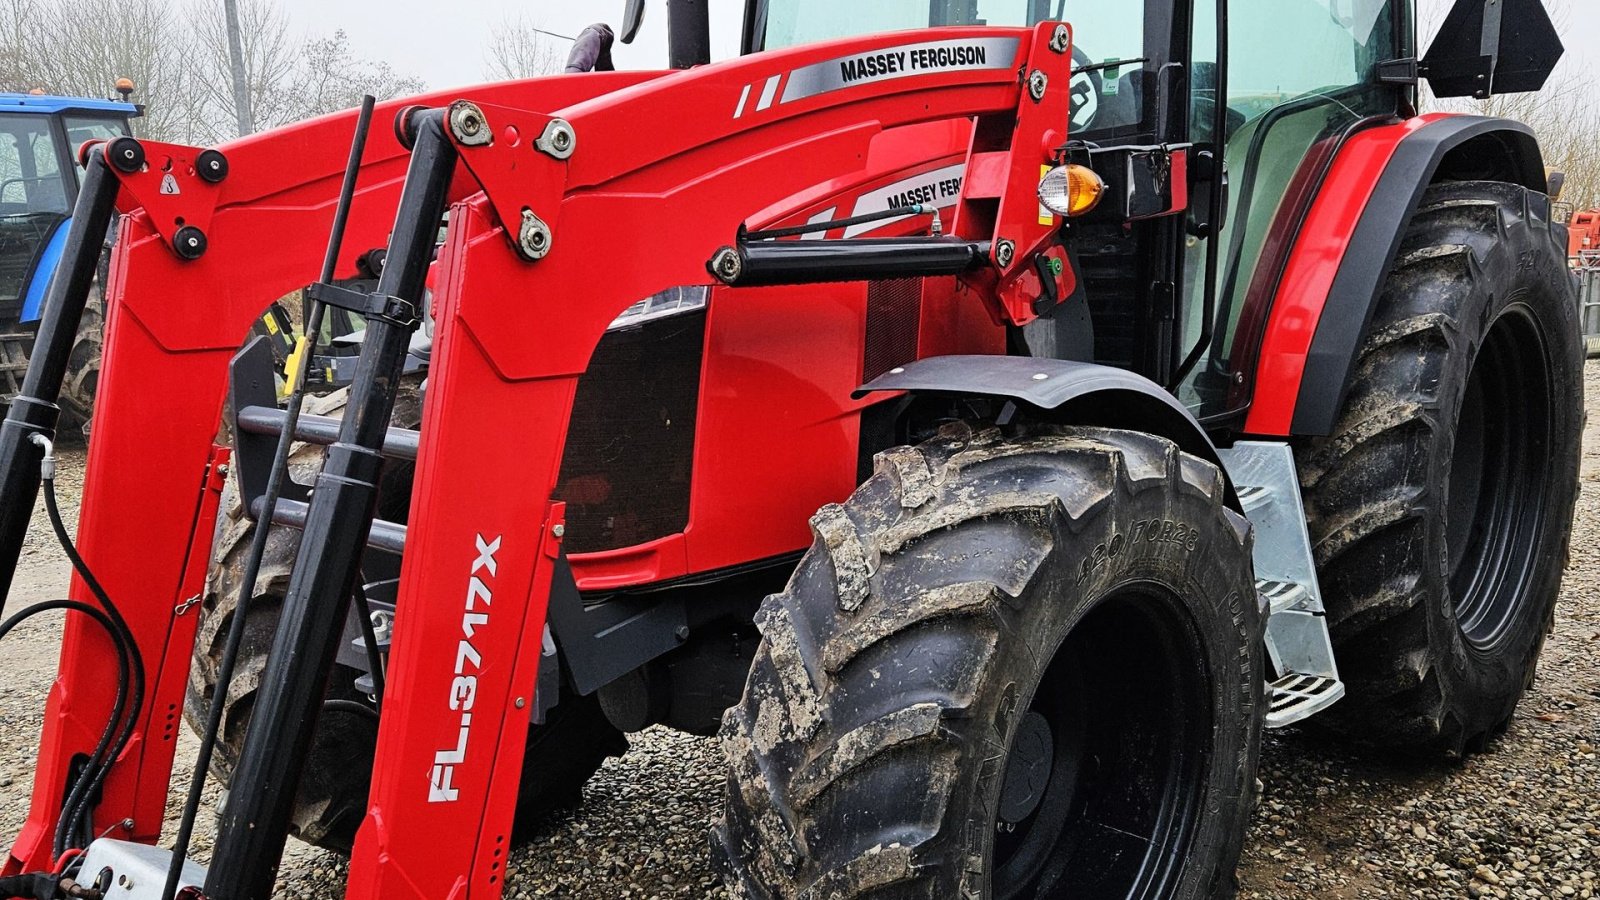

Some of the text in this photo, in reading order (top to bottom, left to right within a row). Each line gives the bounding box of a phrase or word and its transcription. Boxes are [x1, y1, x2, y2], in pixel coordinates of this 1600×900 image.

[840, 46, 986, 83] MASSEY FERGUSON
[887, 183, 937, 210] MASSEY
[428, 532, 502, 803] FL.3717X
